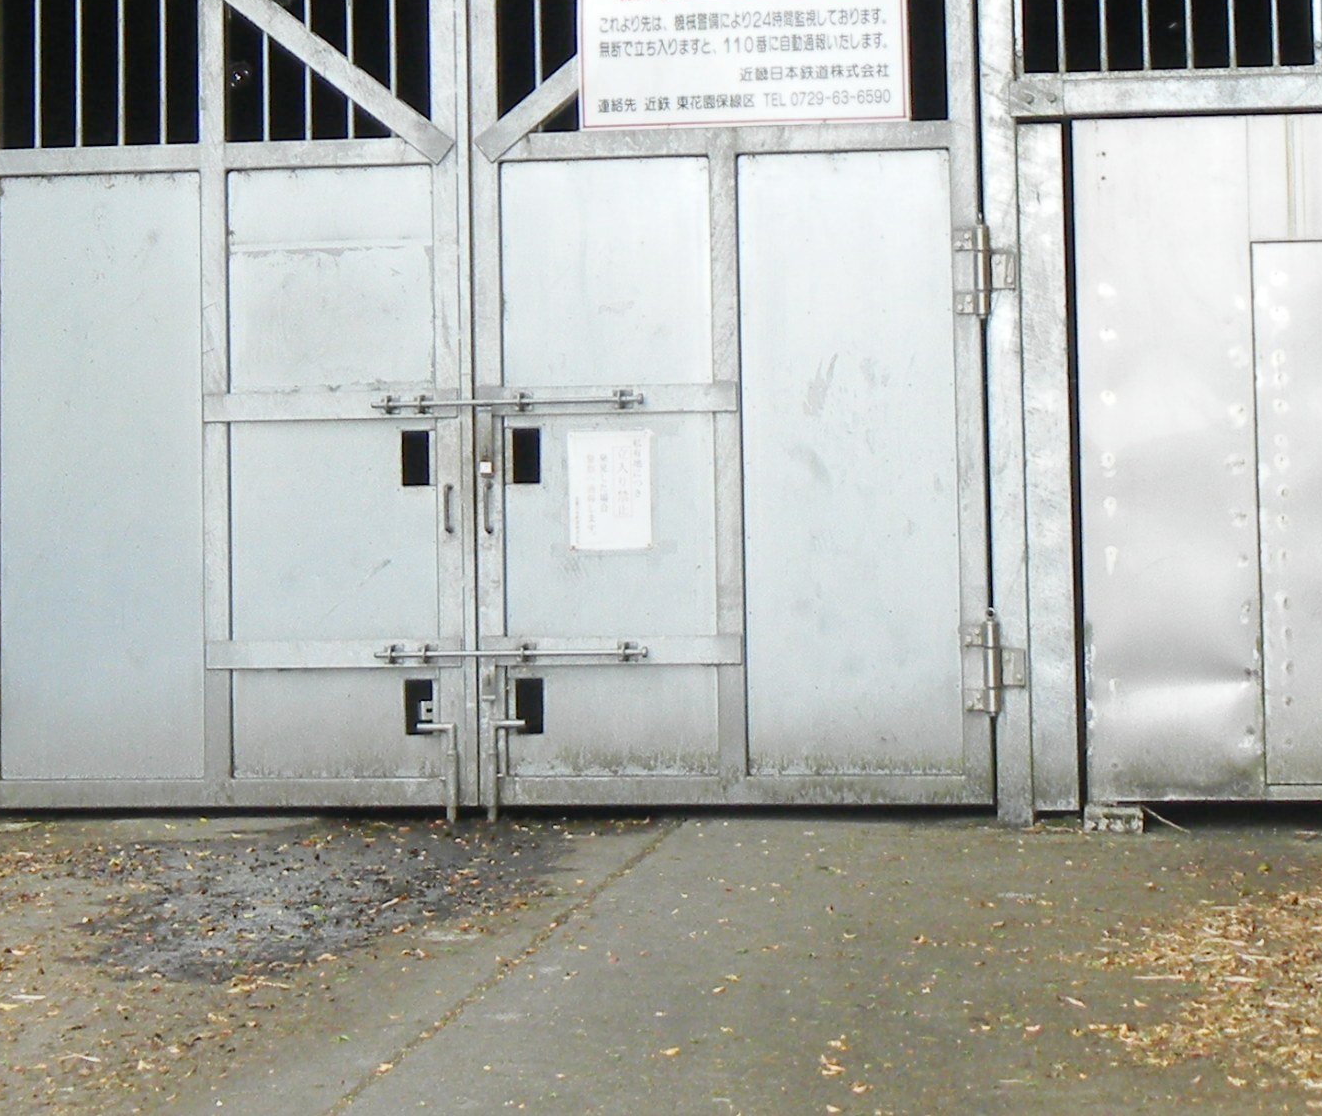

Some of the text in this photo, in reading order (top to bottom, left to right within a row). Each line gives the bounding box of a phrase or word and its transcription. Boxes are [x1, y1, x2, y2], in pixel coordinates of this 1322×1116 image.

[739, 63, 890, 82] 近畿日本鉄道株式会社
[597, 88, 891, 114] 連絡先 近鉄 東花園保線区 TEL 0729-63-6590
